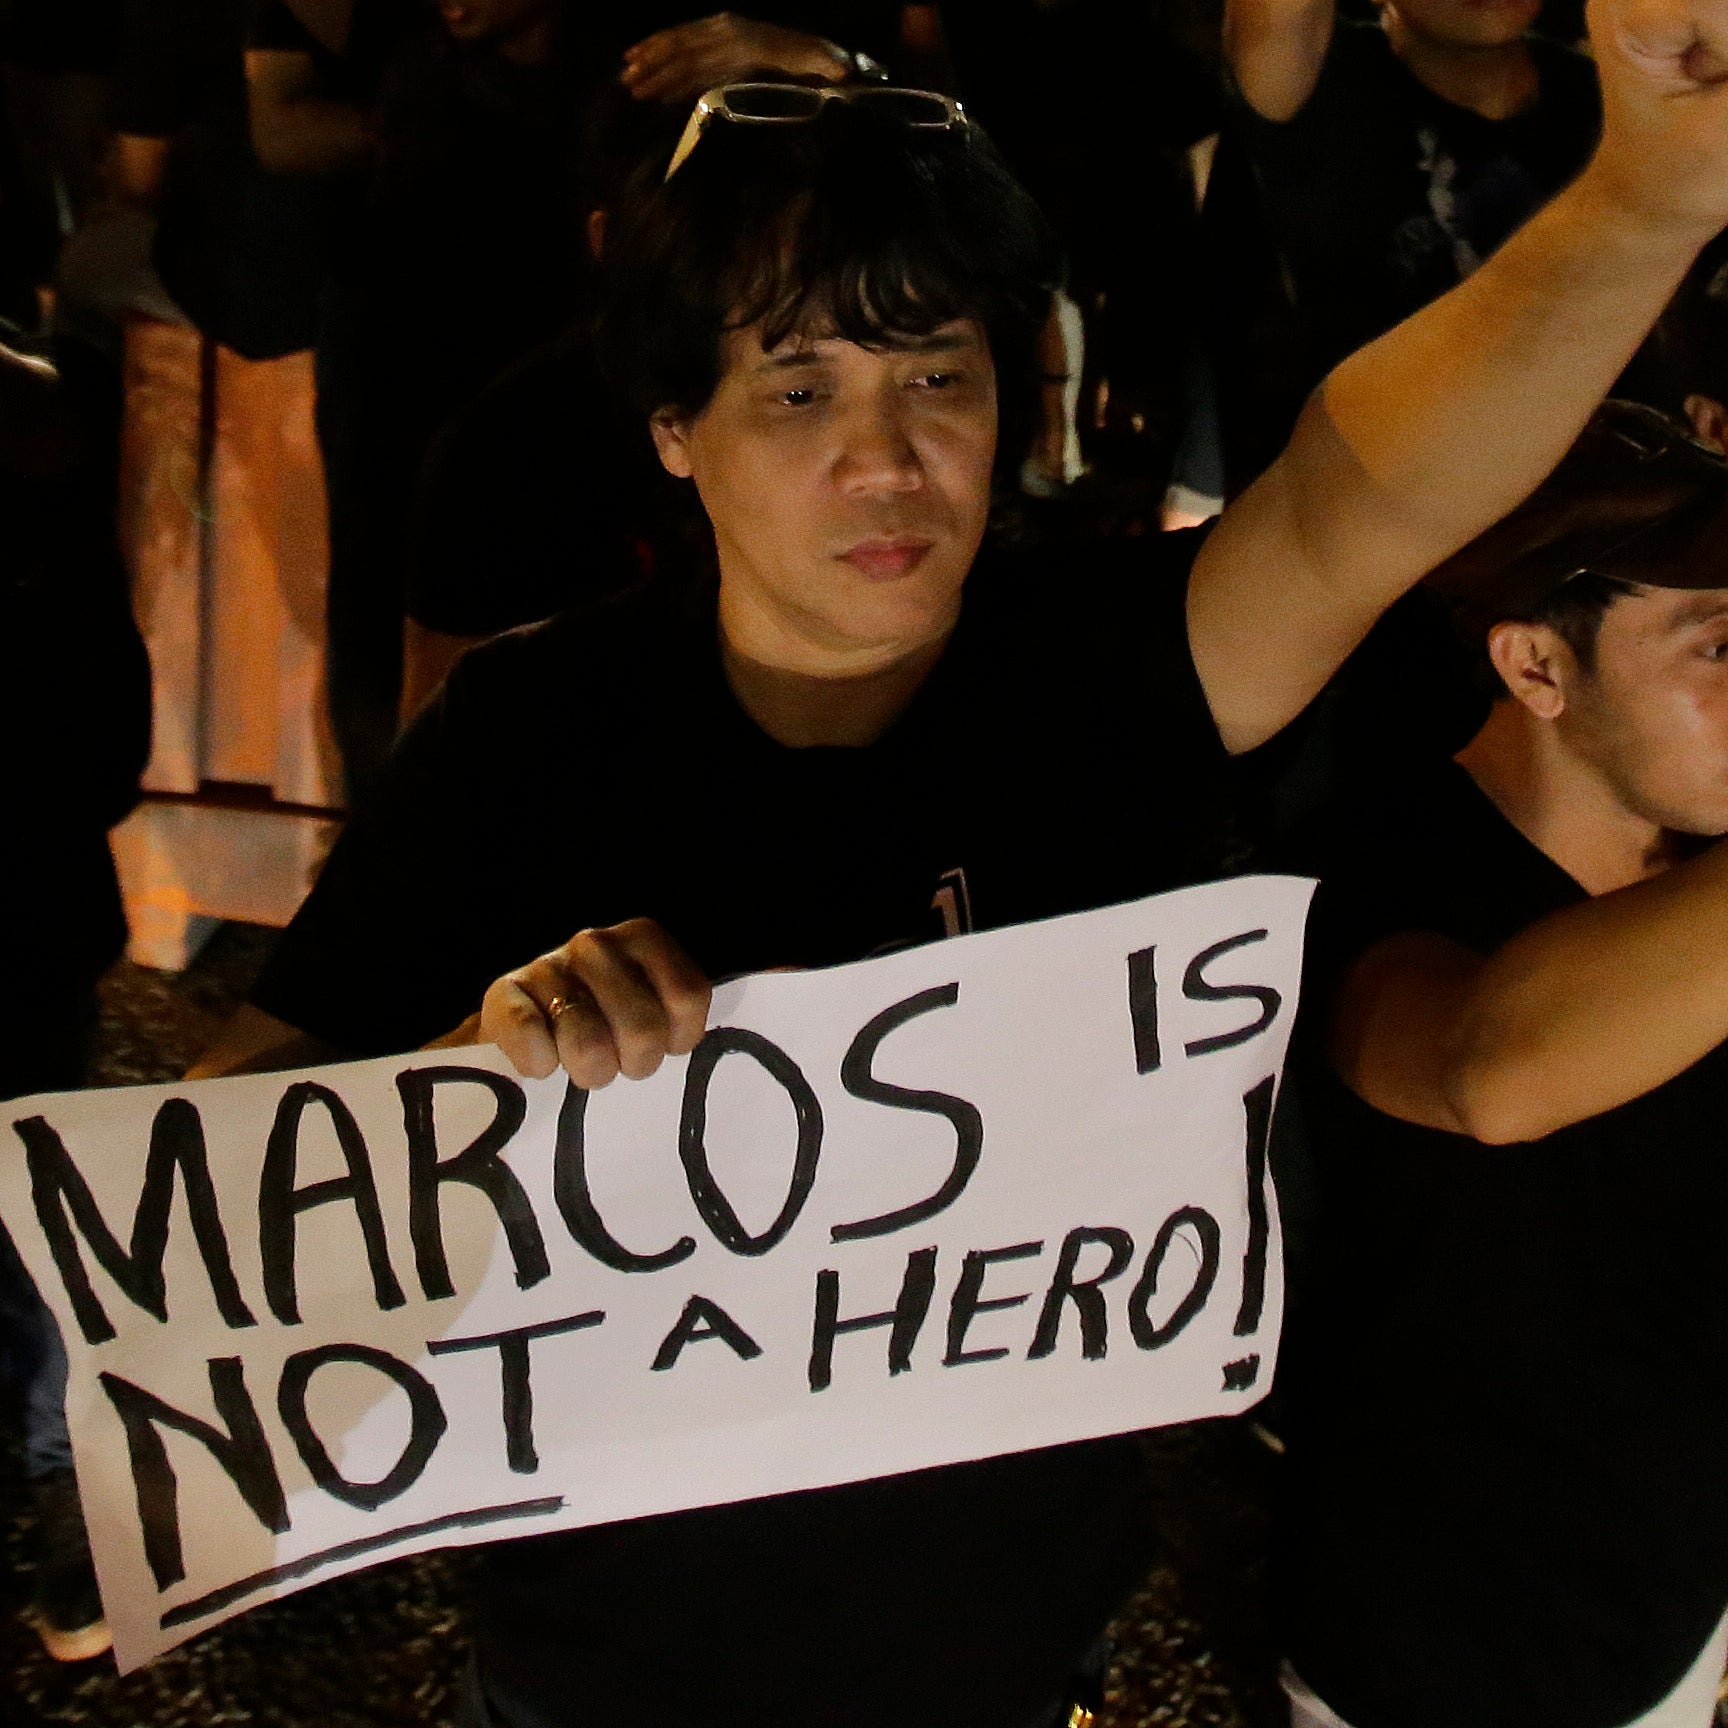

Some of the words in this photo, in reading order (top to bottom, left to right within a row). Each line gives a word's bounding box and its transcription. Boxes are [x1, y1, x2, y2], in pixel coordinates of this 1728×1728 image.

[13, 981, 983, 1343] MARCOS
[1126, 929, 1282, 1074] IS
[100, 1310, 608, 1589] NOT
[650, 1295, 762, 1372] A
[808, 1073, 1277, 1393] HERO!
